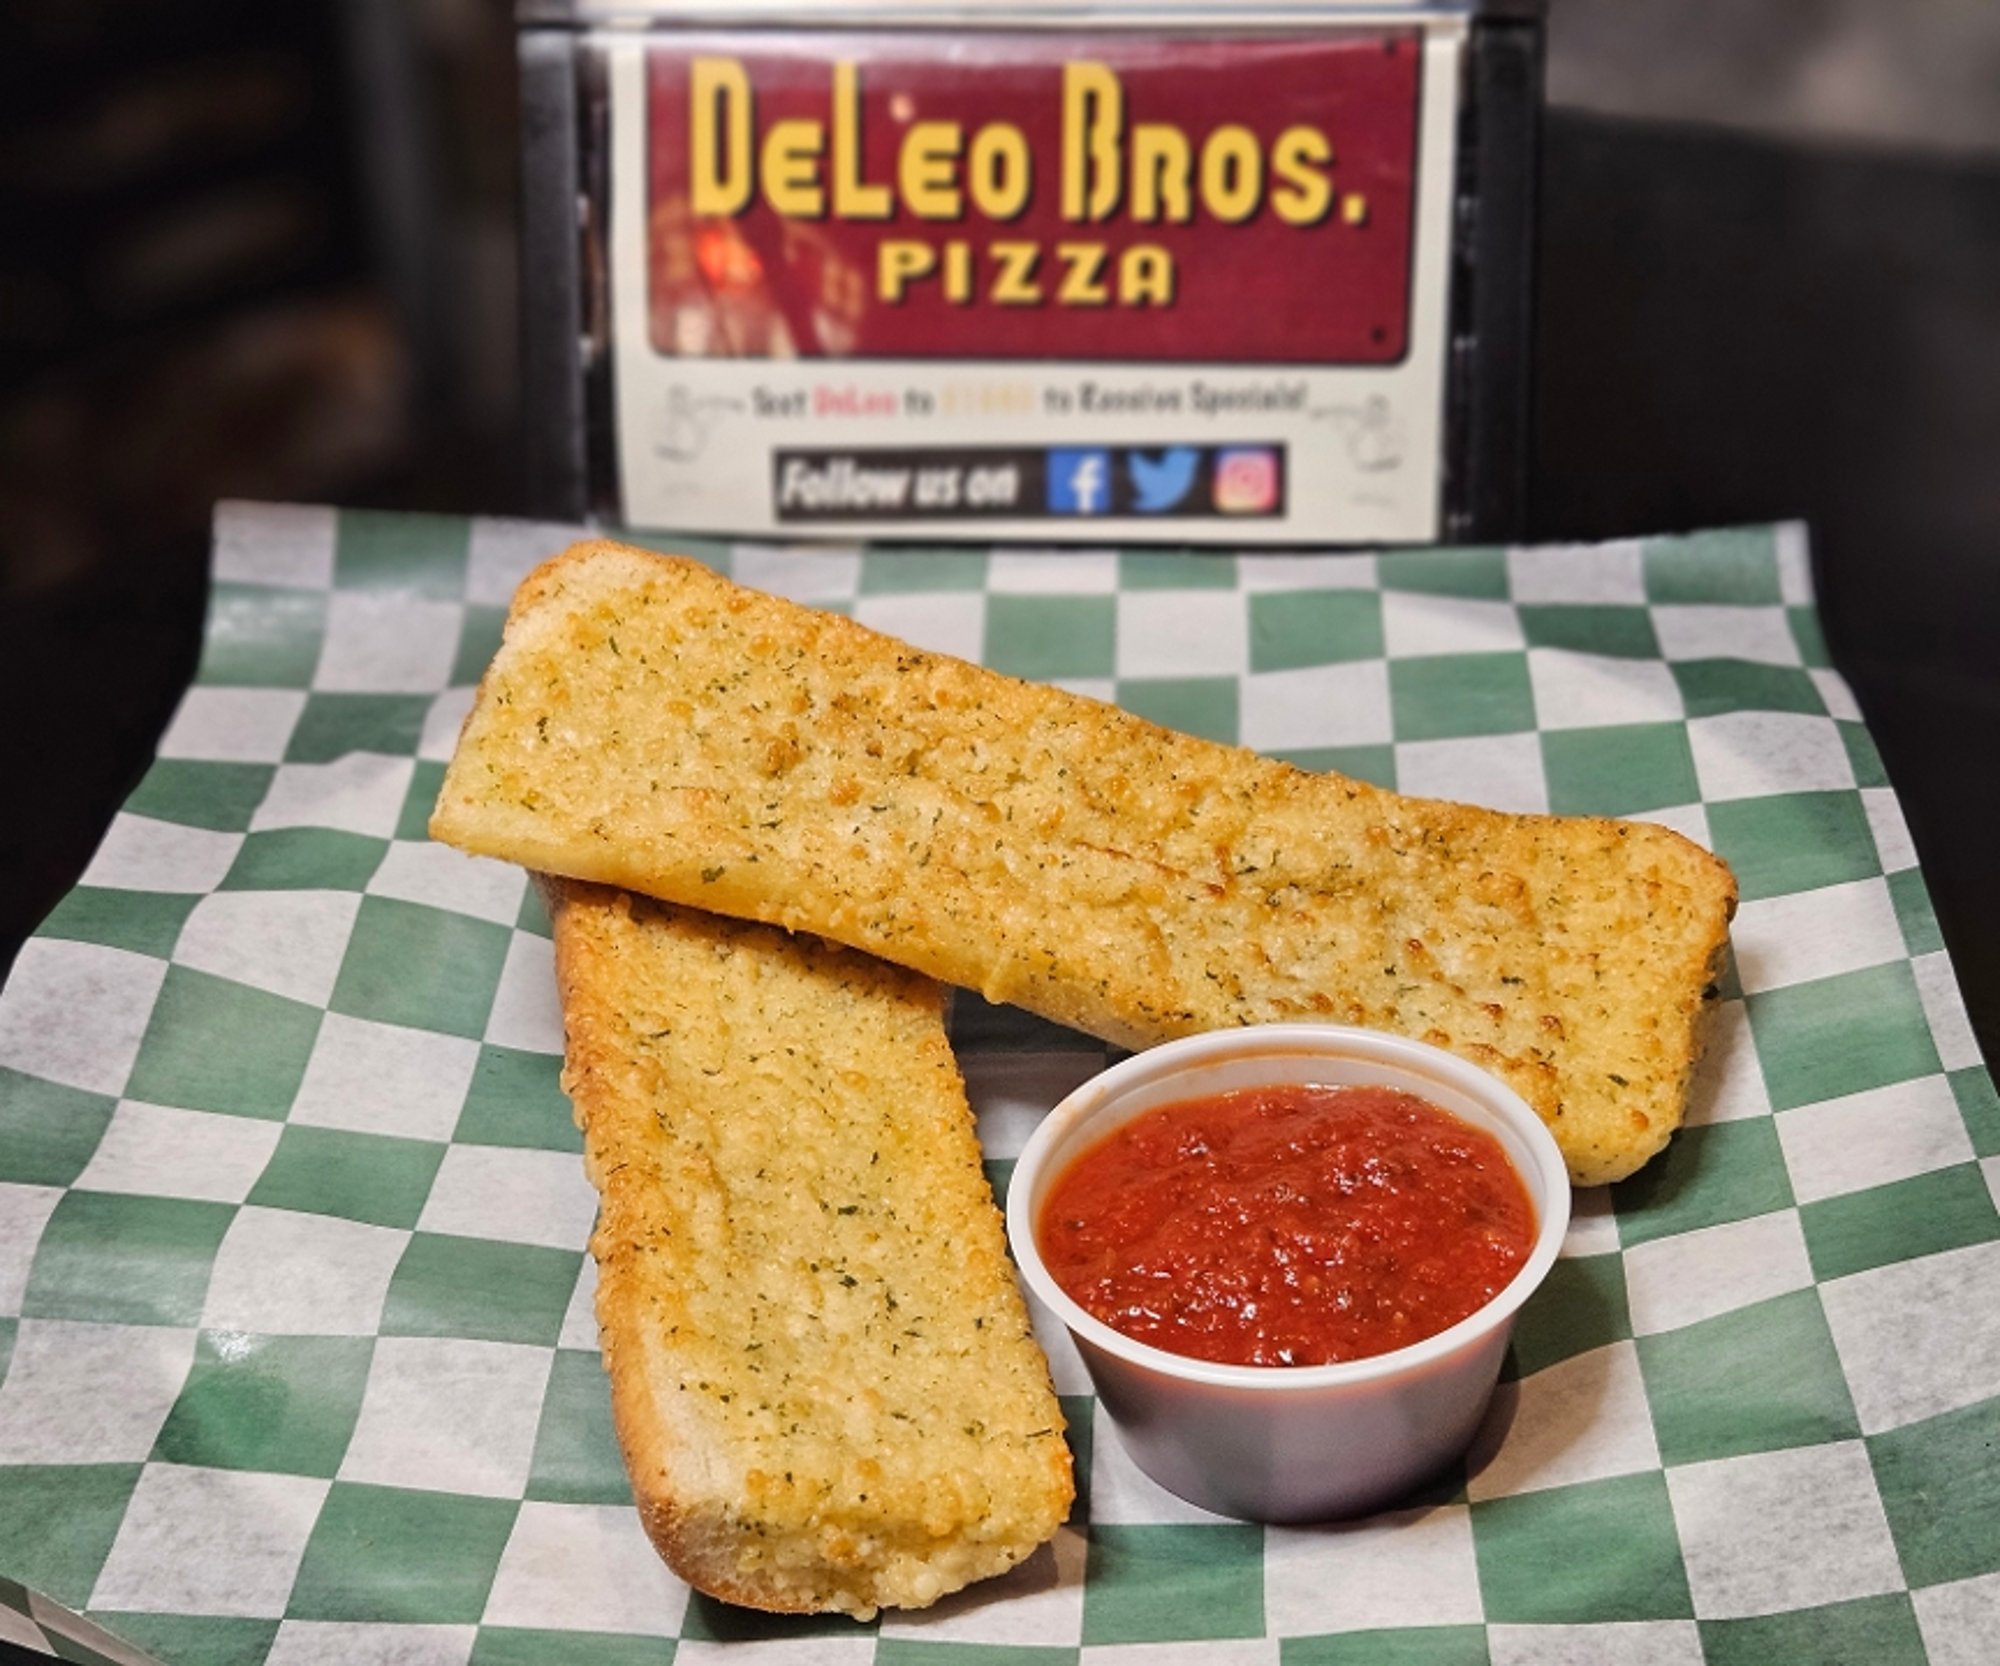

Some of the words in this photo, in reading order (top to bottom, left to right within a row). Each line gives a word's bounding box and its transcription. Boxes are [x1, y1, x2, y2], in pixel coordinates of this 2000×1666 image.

[877, 241, 1174, 307] PIZZA
[781, 456, 911, 508] Follow
[913, 466, 960, 507] us
[966, 464, 1019, 507] on
